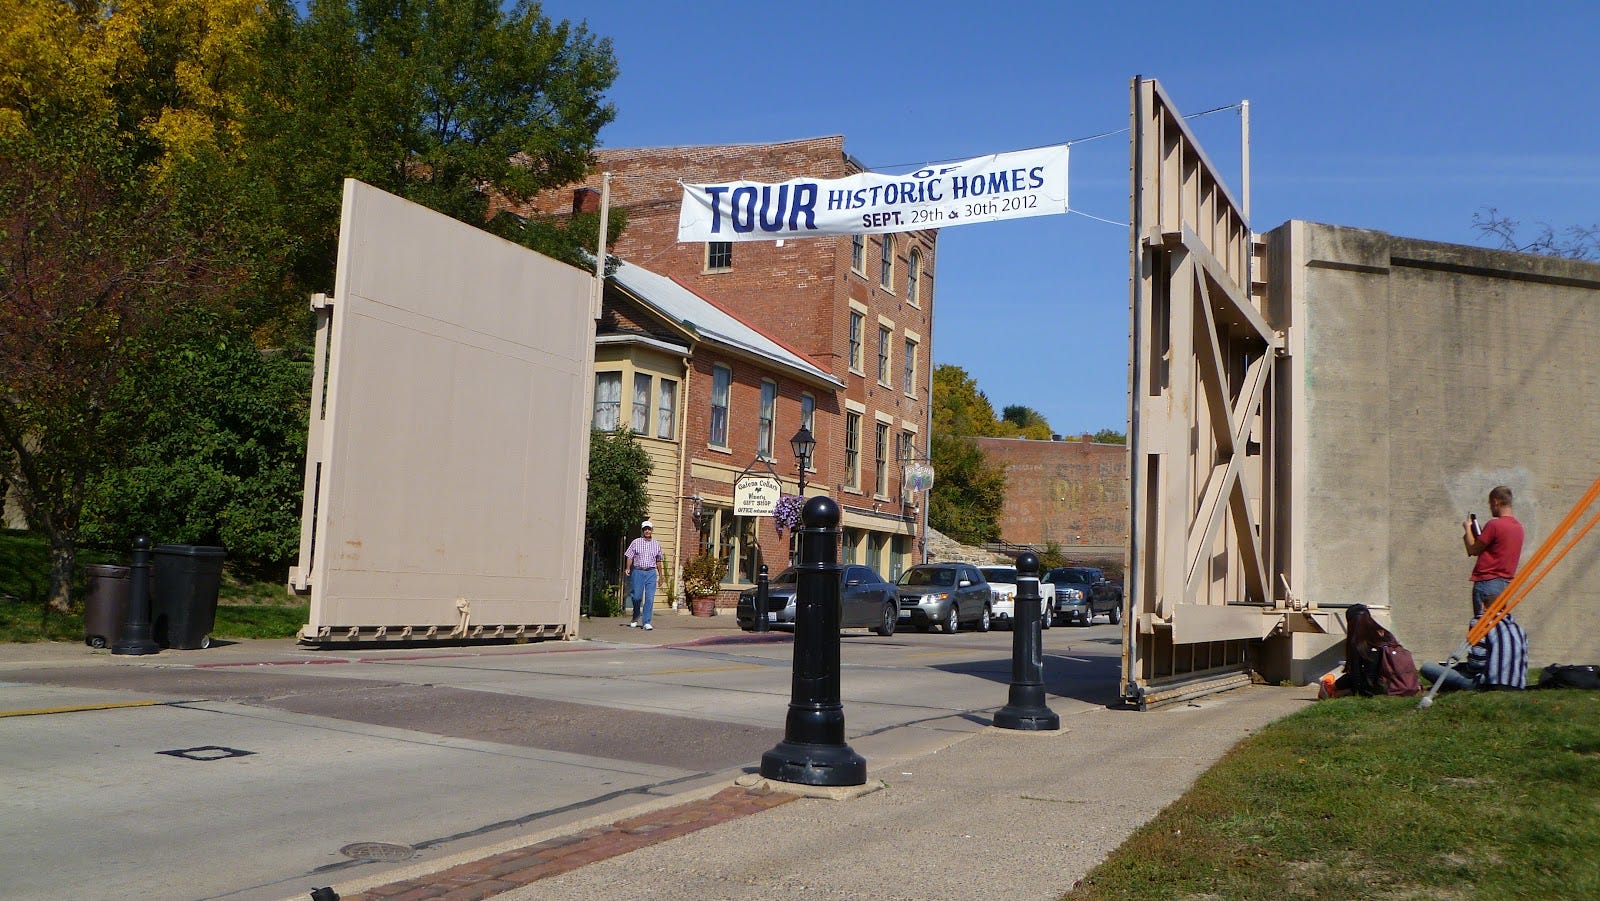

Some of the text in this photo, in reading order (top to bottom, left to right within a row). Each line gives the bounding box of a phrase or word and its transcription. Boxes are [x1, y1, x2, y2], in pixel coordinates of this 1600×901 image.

[828, 166, 1044, 210] HISTORIC HOMES
[912, 166, 962, 179] OF
[705, 183, 818, 233] TOUR
[862, 194, 1038, 228] SEPT. 29th & 30th 2012
